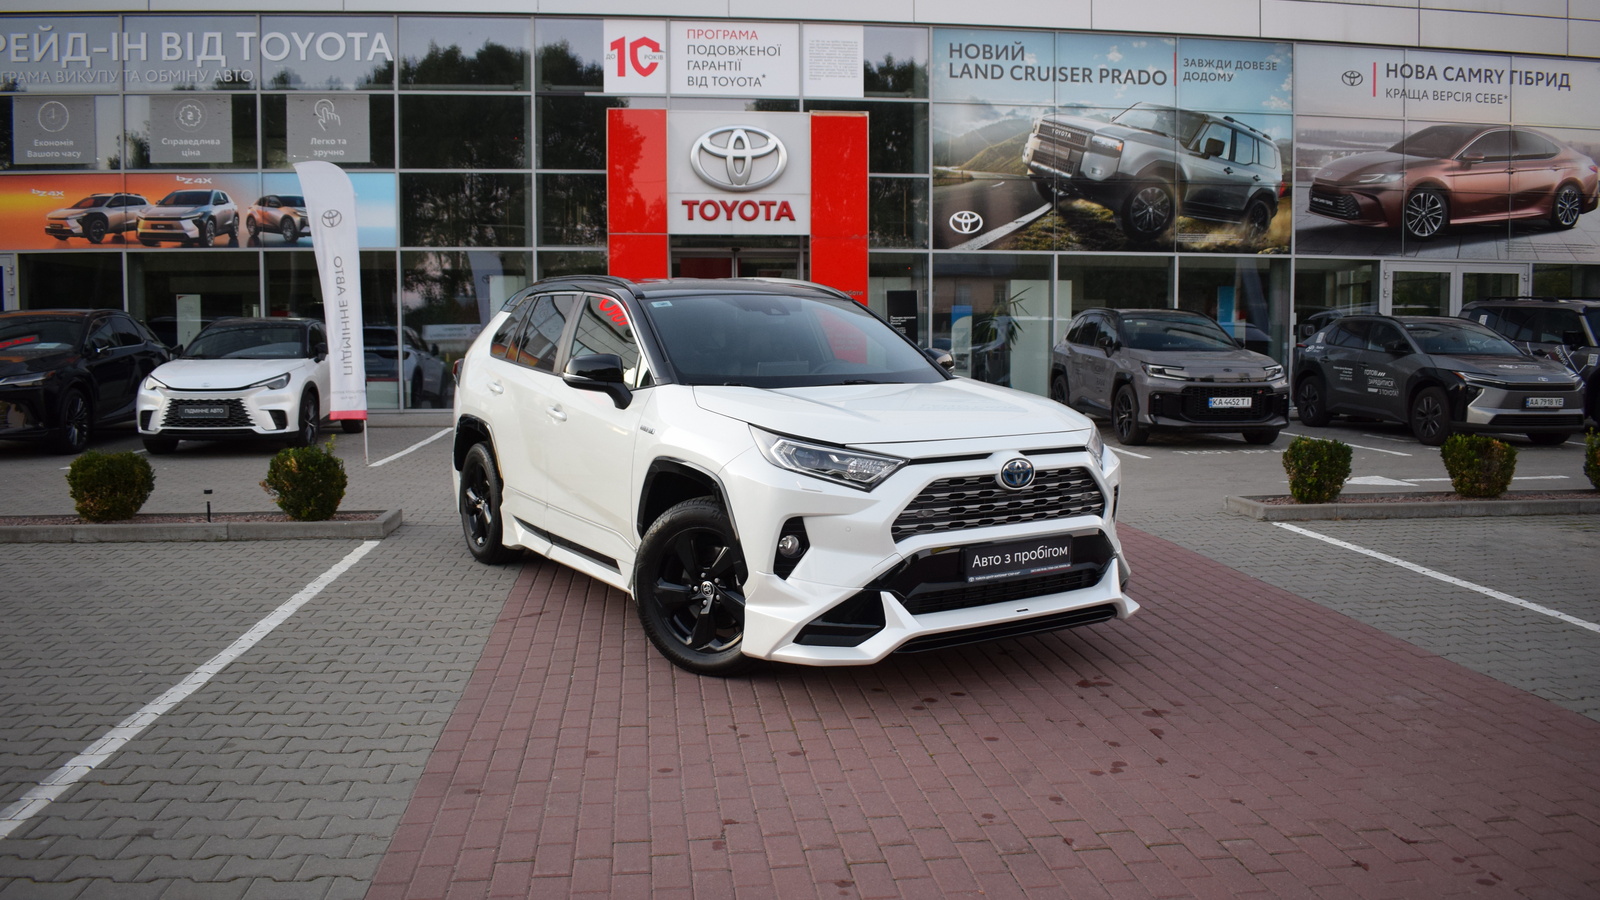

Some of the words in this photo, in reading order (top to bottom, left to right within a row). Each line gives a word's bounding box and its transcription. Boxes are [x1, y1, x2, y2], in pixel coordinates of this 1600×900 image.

[686, 28, 759, 41] ПРОГРАМА
[161, 32, 227, 68] ВІД
[236, 32, 393, 62] TOYOTA
[686, 43, 782, 57] ПОДОВЖЕНОЇ
[949, 41, 1025, 62] НОВИЙ
[686, 59, 742, 72] ГАРАНТІЇ
[1183, 57, 1232, 71] ЗАВЖДИ
[1234, 60, 1278, 72] ДОВЕЗЕ
[56, 70, 119, 83] ВИКУПУ
[122, 70, 141, 83] ТА
[145, 69, 210, 83] ОБМІНУ
[213, 70, 254, 83] АВТО
[948, 63, 1004, 81] LAND
[1010, 65, 1094, 84] CRUISER
[1099, 68, 1168, 86] PRADO
[1182, 71, 1234, 84] ДОДОМУ
[1385, 62, 1438, 81] НОВА
[1443, 66, 1504, 85] CAMRY
[1509, 70, 1571, 91] ГІБРИД
[686, 76, 709, 88] ВІД
[1385, 88, 1429, 102] КРАЩА
[1432, 90, 1472, 103] ВЕРСІЯ
[34, 139, 74, 147] Економія
[161, 137, 221, 147] Справедлива
[310, 137, 336, 145] Легко
[26, 150, 60, 158] Вашого
[61, 151, 82, 159] часу
[181, 148, 201, 157] ціна
[313, 149, 345, 158] зручно
[681, 200, 796, 222] TOYOTA
[972, 555, 1002, 568] Авто
[1004, 554, 1011, 564] з
[1014, 545, 1068, 564] пробігом
